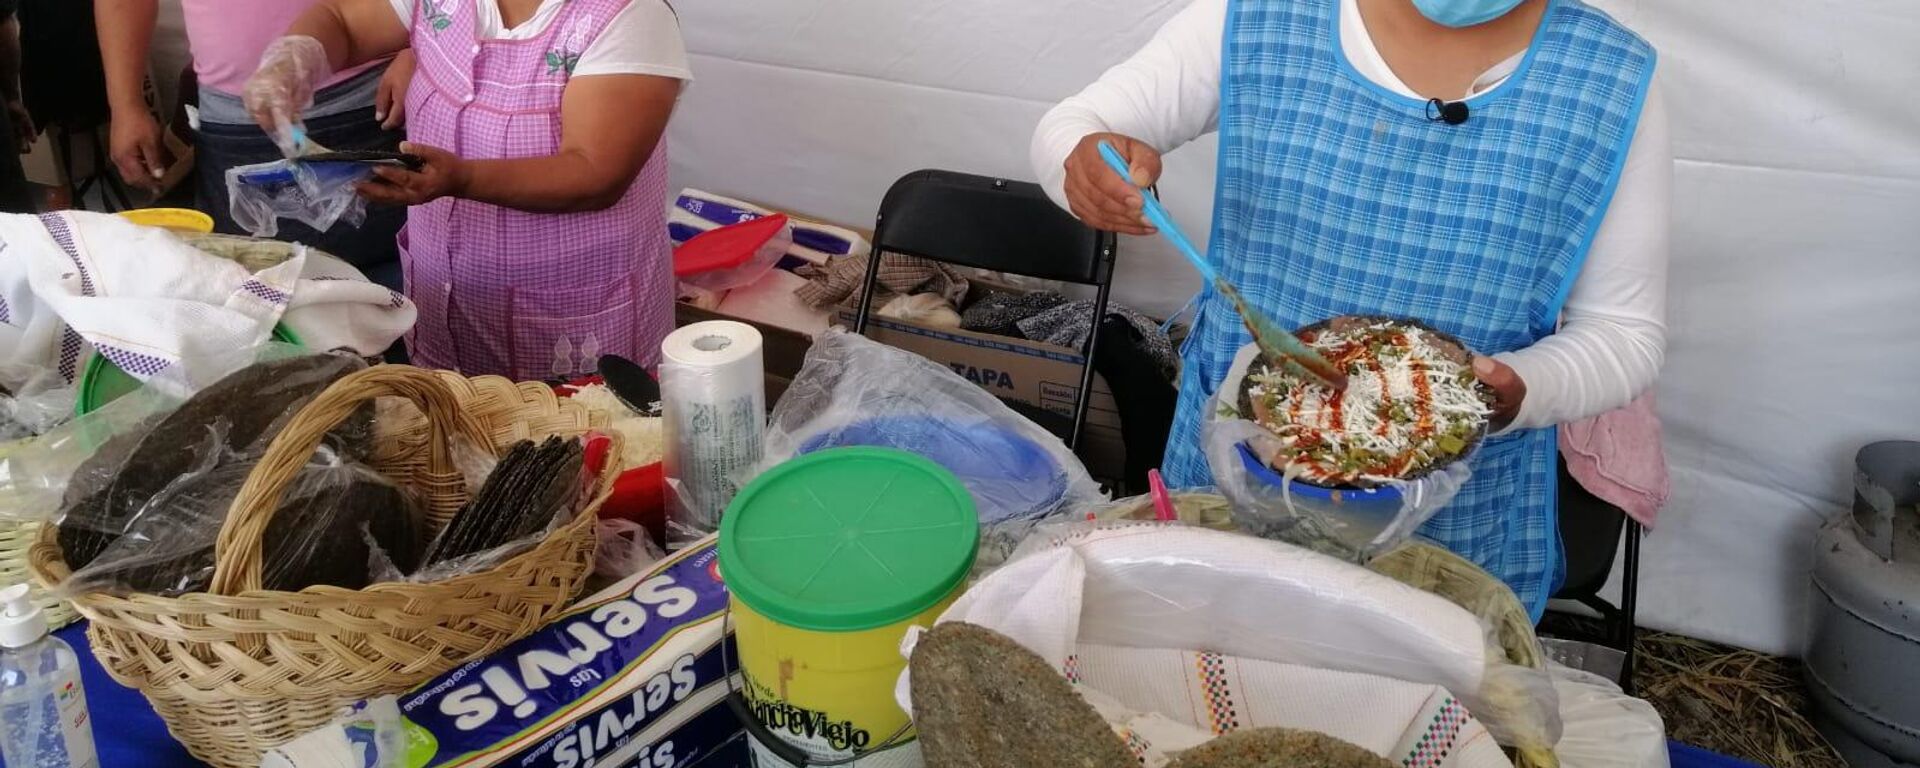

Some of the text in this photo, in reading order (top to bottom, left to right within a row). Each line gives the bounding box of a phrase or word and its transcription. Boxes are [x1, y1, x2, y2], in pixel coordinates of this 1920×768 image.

[950, 361, 1014, 390] TAPA
[439, 574, 698, 731] Servis
[552, 653, 697, 768] Servis
